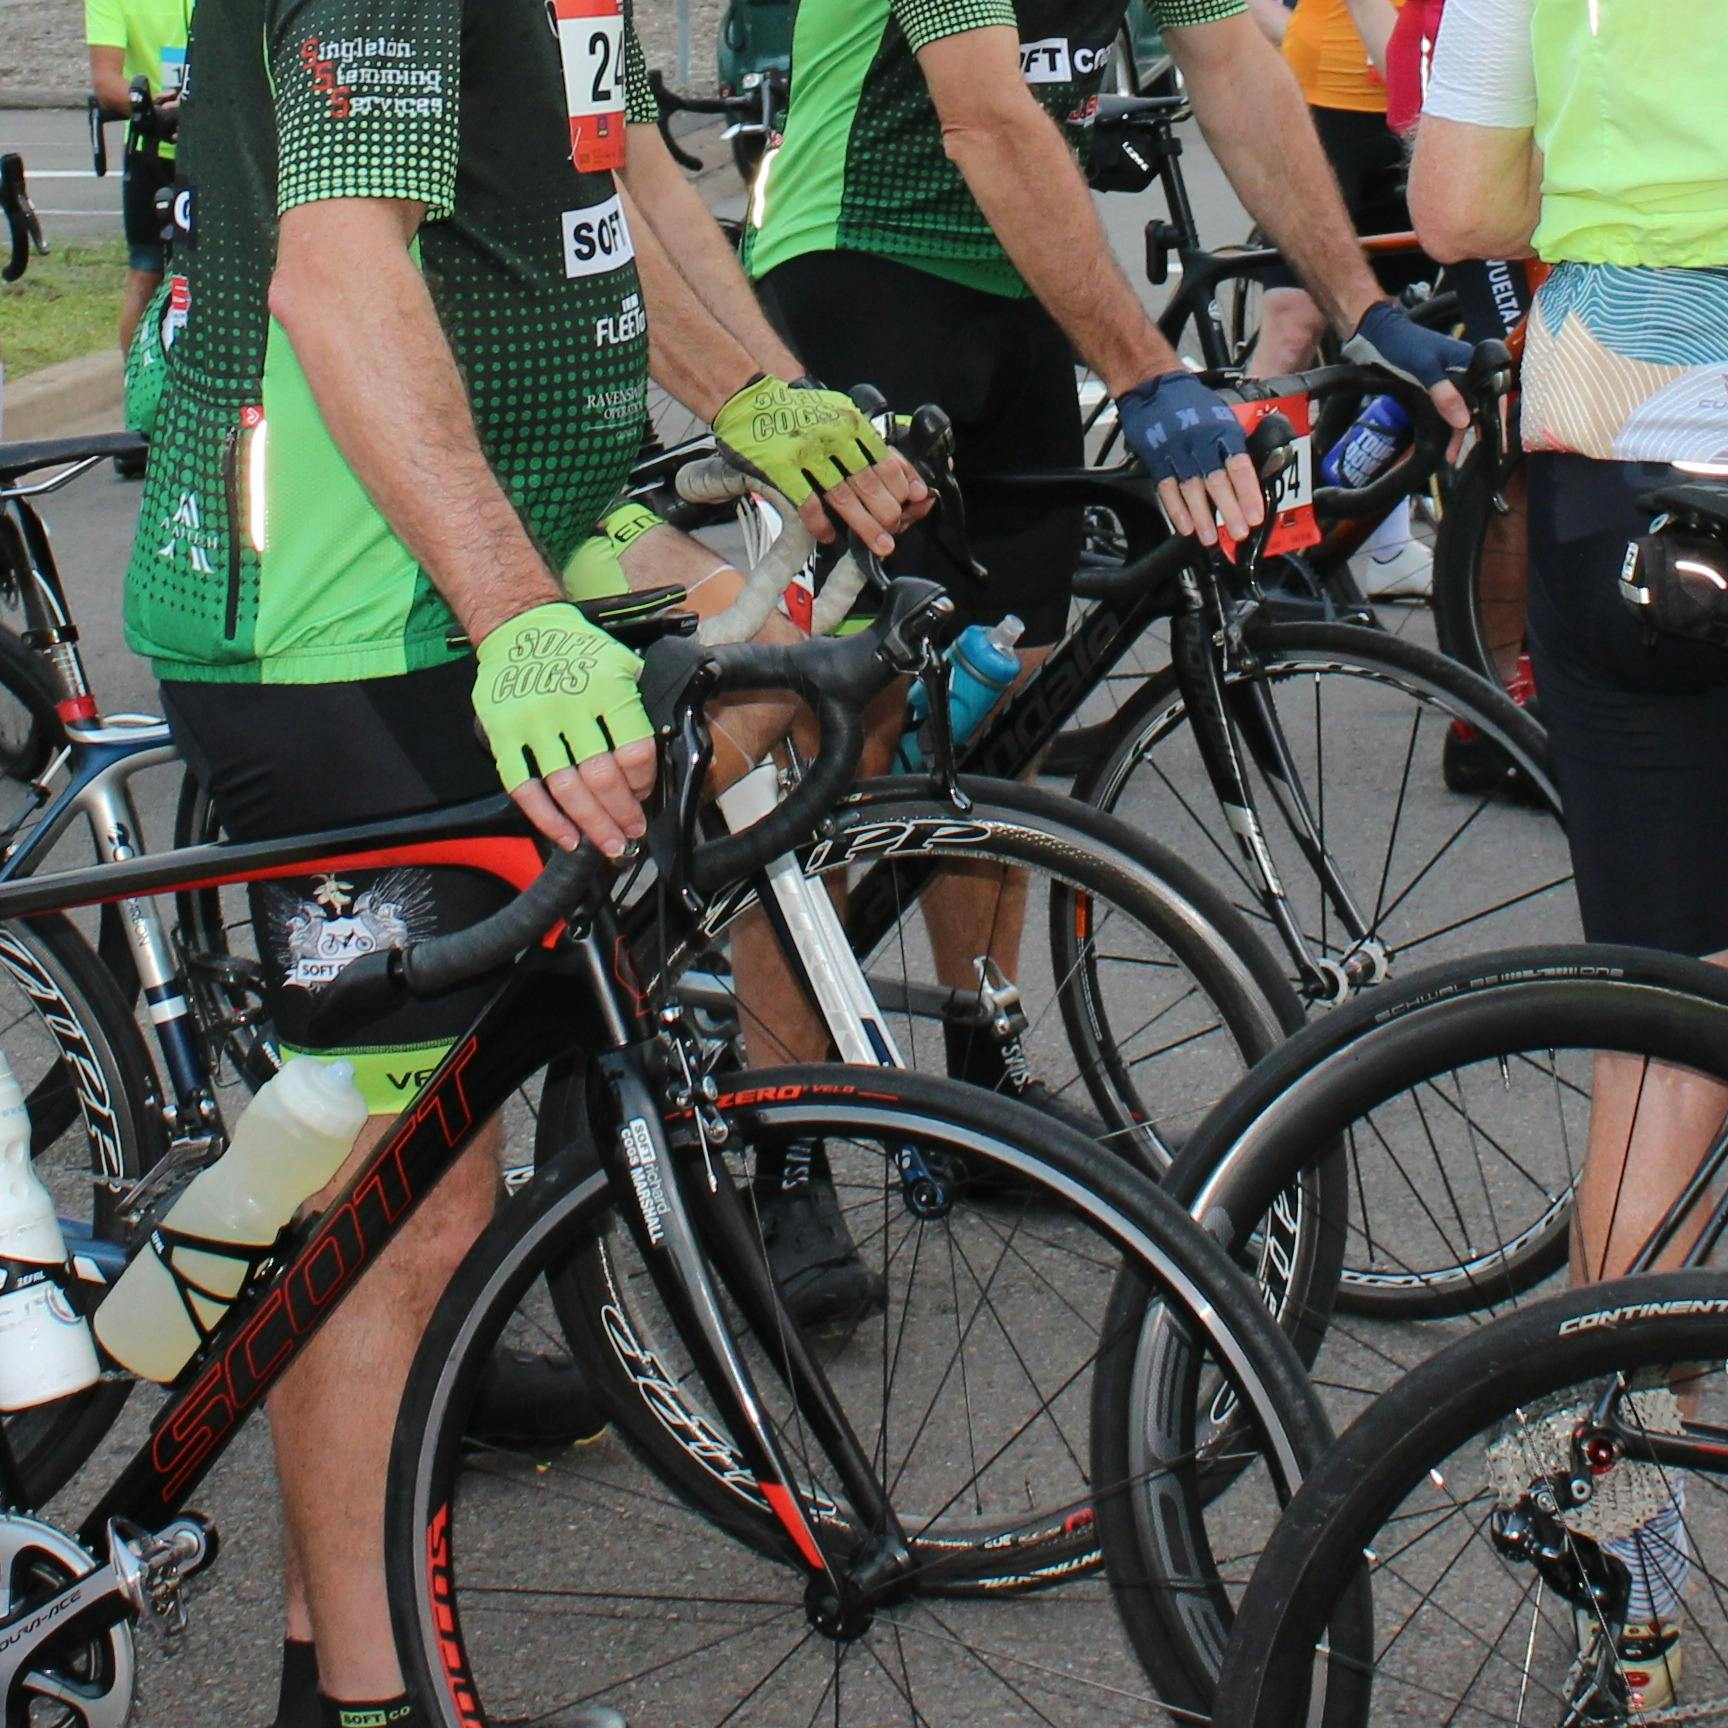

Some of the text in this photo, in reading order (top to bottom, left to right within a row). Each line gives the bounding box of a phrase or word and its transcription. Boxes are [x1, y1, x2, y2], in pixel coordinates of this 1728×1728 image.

[491, 656, 598, 704] COGS
[716, 1084, 802, 1109] ZERO
[152, 1035, 478, 1502] SCOTT
